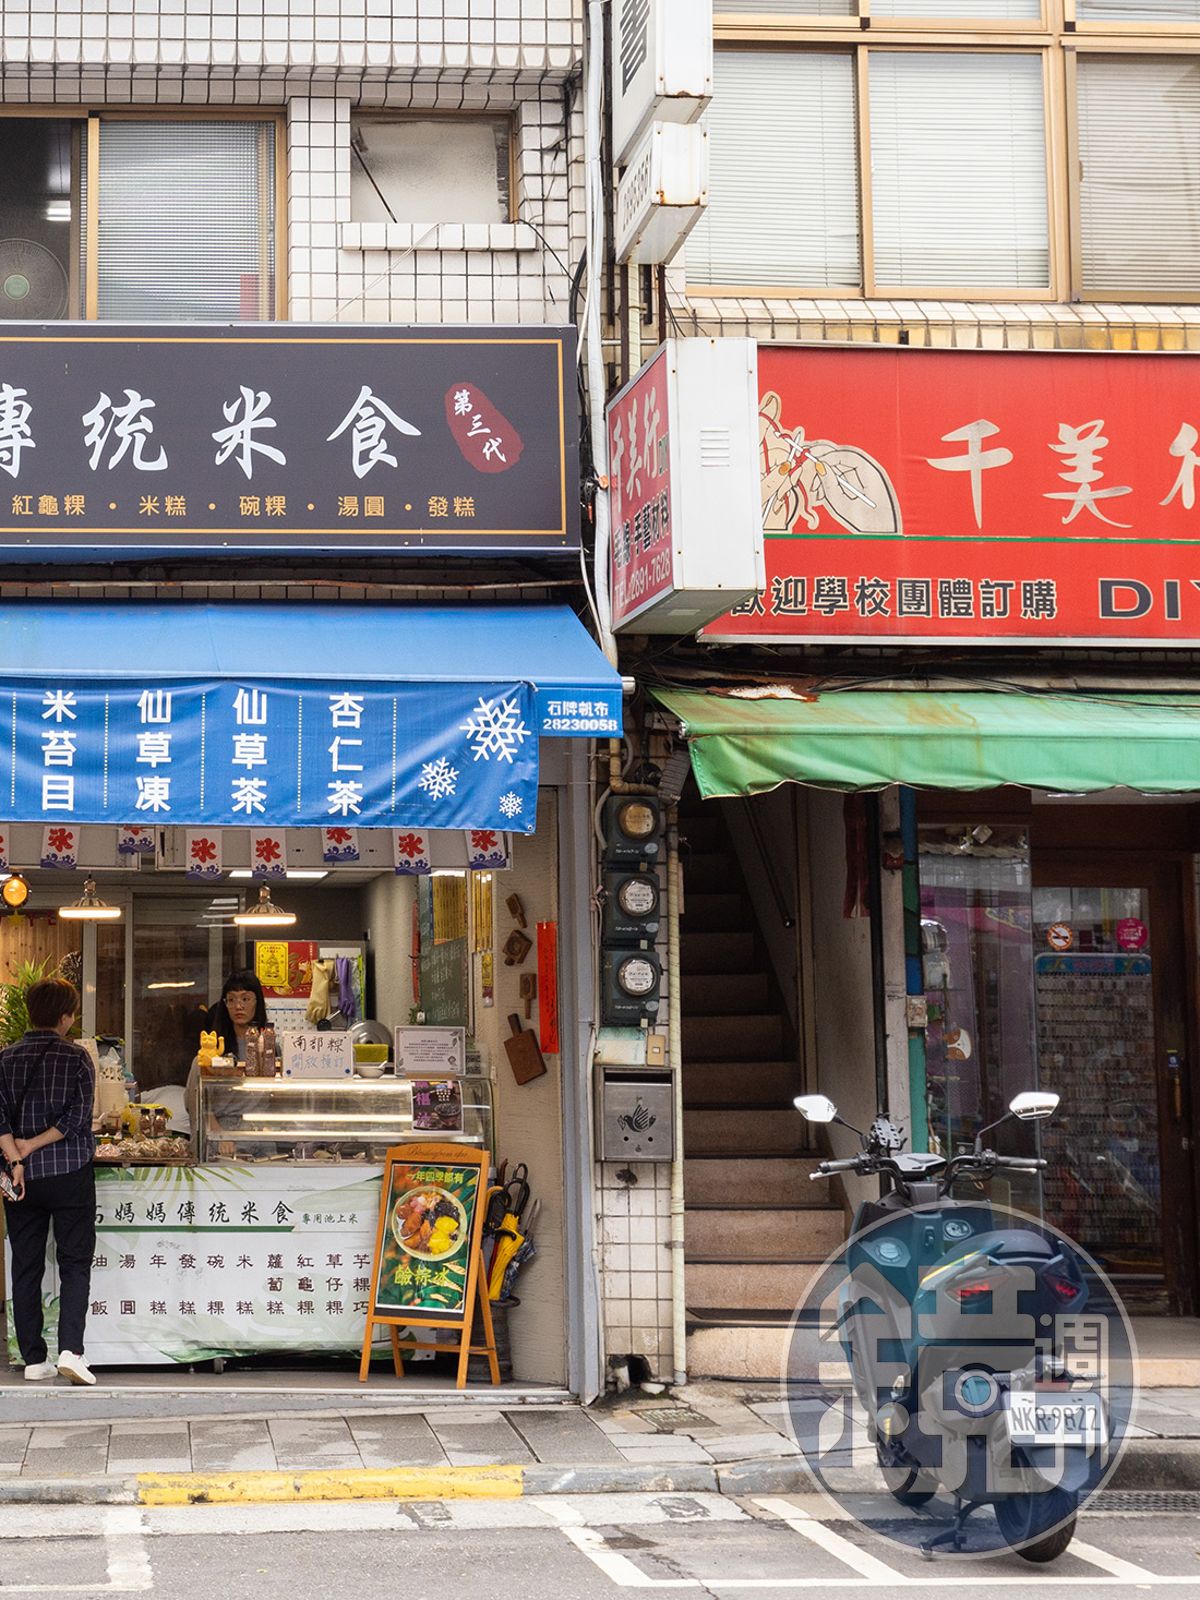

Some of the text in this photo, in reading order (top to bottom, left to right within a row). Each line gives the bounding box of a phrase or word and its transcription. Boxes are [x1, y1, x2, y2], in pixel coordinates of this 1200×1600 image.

[453, 389, 506, 463] 第三代
[11, 494, 86, 516] 紅龜粿
[139, 496, 186, 516] 米糕
[239, 496, 287, 517] 碗粿
[337, 496, 385, 517] 湯圓
[427, 496, 475, 517] 發糕
[1099, 578, 1200, 620] DI
[543, 718, 618, 731] 28230058
[547, 701, 609, 717] 石牌帆布
[40, 690, 78, 812] 米苔目
[135, 689, 173, 813] 仙草凍
[230, 689, 268, 815] 仙草茶
[326, 692, 364, 817] 杏仁茶
[302, 1213, 358, 1225] 專用池上米
[90, 1254, 109, 1315] 油飯
[119, 1254, 136, 1314] 湯圓
[150, 1254, 168, 1314] 年糕
[178, 1254, 197, 1315] 發糕
[207, 1254, 225, 1315] 碗粿
[236, 1254, 254, 1315] 米糕
[297, 1254, 315, 1315] 紅龜粿
[326, 1254, 344, 1315] 草仔粿
[353, 1254, 371, 1315] 芋粿巧
